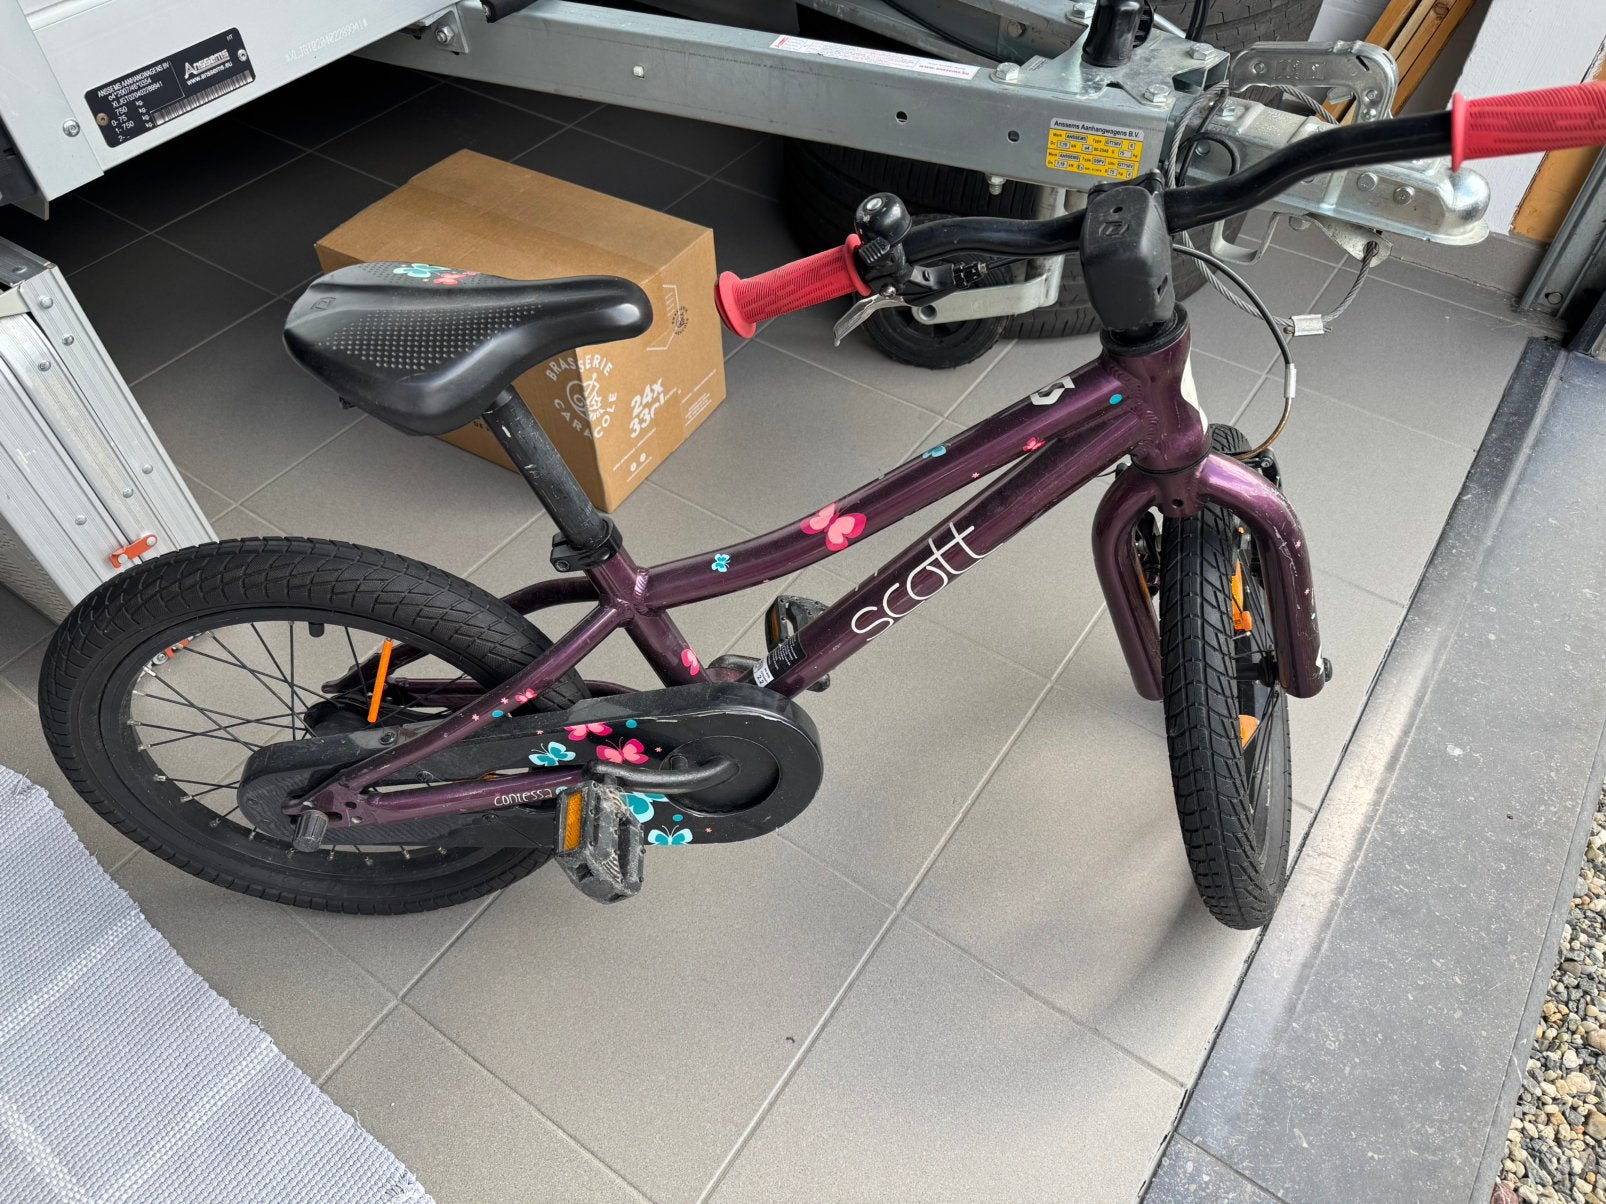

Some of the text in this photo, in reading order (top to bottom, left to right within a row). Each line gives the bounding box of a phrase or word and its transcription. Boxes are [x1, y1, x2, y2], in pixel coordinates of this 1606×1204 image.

[184, 48, 231, 79] Anssems
[186, 61, 233, 86] www.anssems.eu
[97, 80, 123, 98] ANSSEMS
[114, 106, 128, 116] 750
[118, 114, 128, 122] 75
[121, 120, 135, 130] 750
[1054, 120, 1080, 130] Anssems
[1080, 124, 1127, 137] Aanhangwagens
[546, 354, 613, 382] BRASSERIE
[554, 392, 618, 440] CARACOLE
[493, 788, 553, 806] contessa
